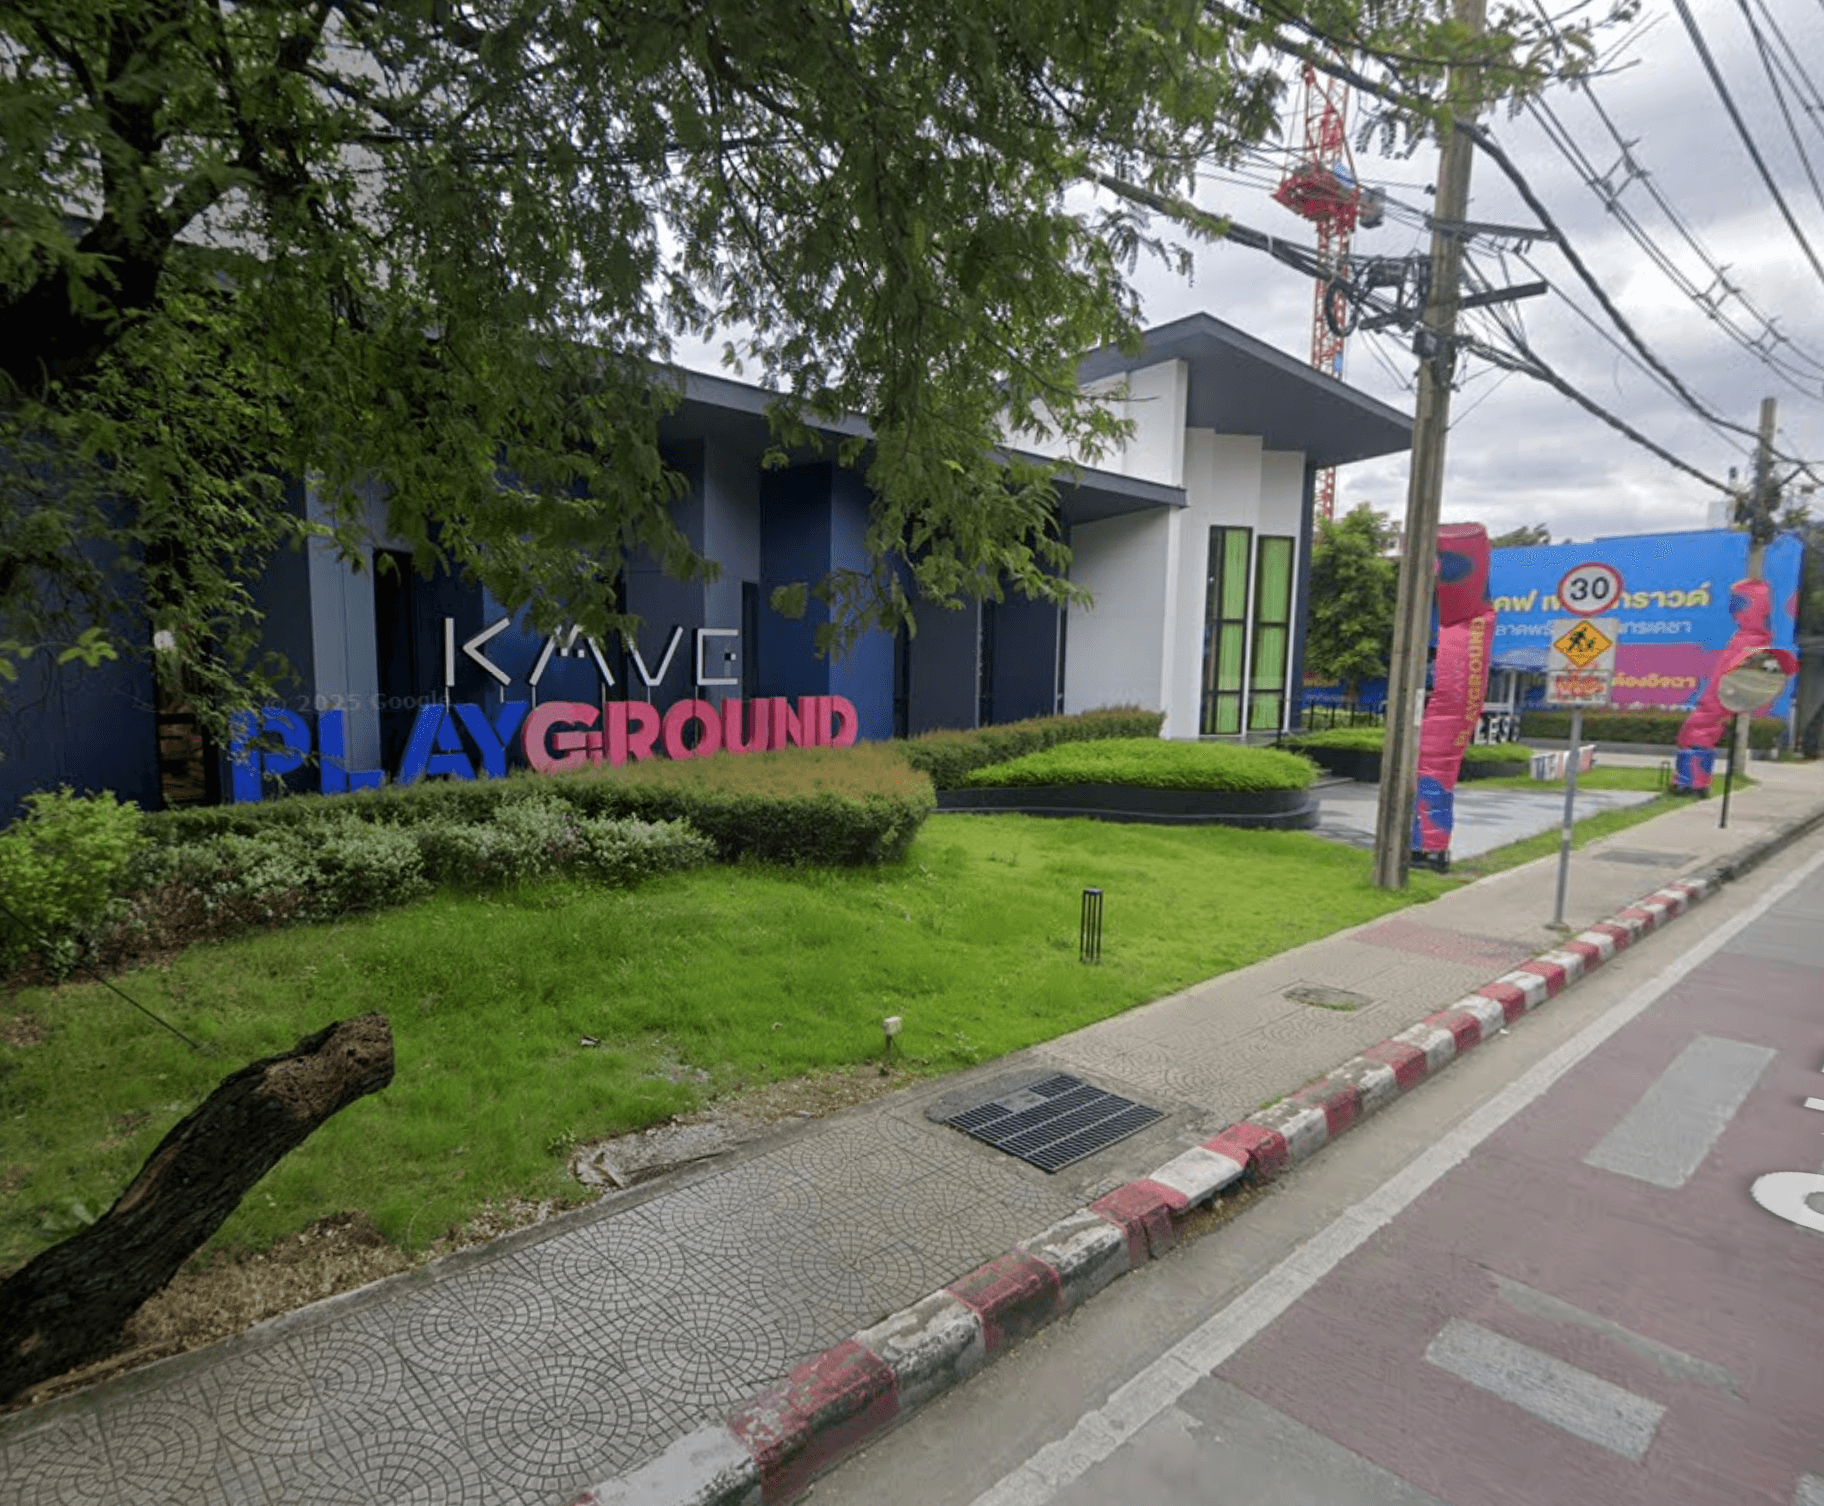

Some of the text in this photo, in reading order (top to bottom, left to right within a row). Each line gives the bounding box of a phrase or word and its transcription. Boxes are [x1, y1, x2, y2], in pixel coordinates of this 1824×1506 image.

[1570, 576, 1610, 601] 30
[445, 617, 740, 688] KAVE
[229, 694, 859, 804] PLAYGROUND
